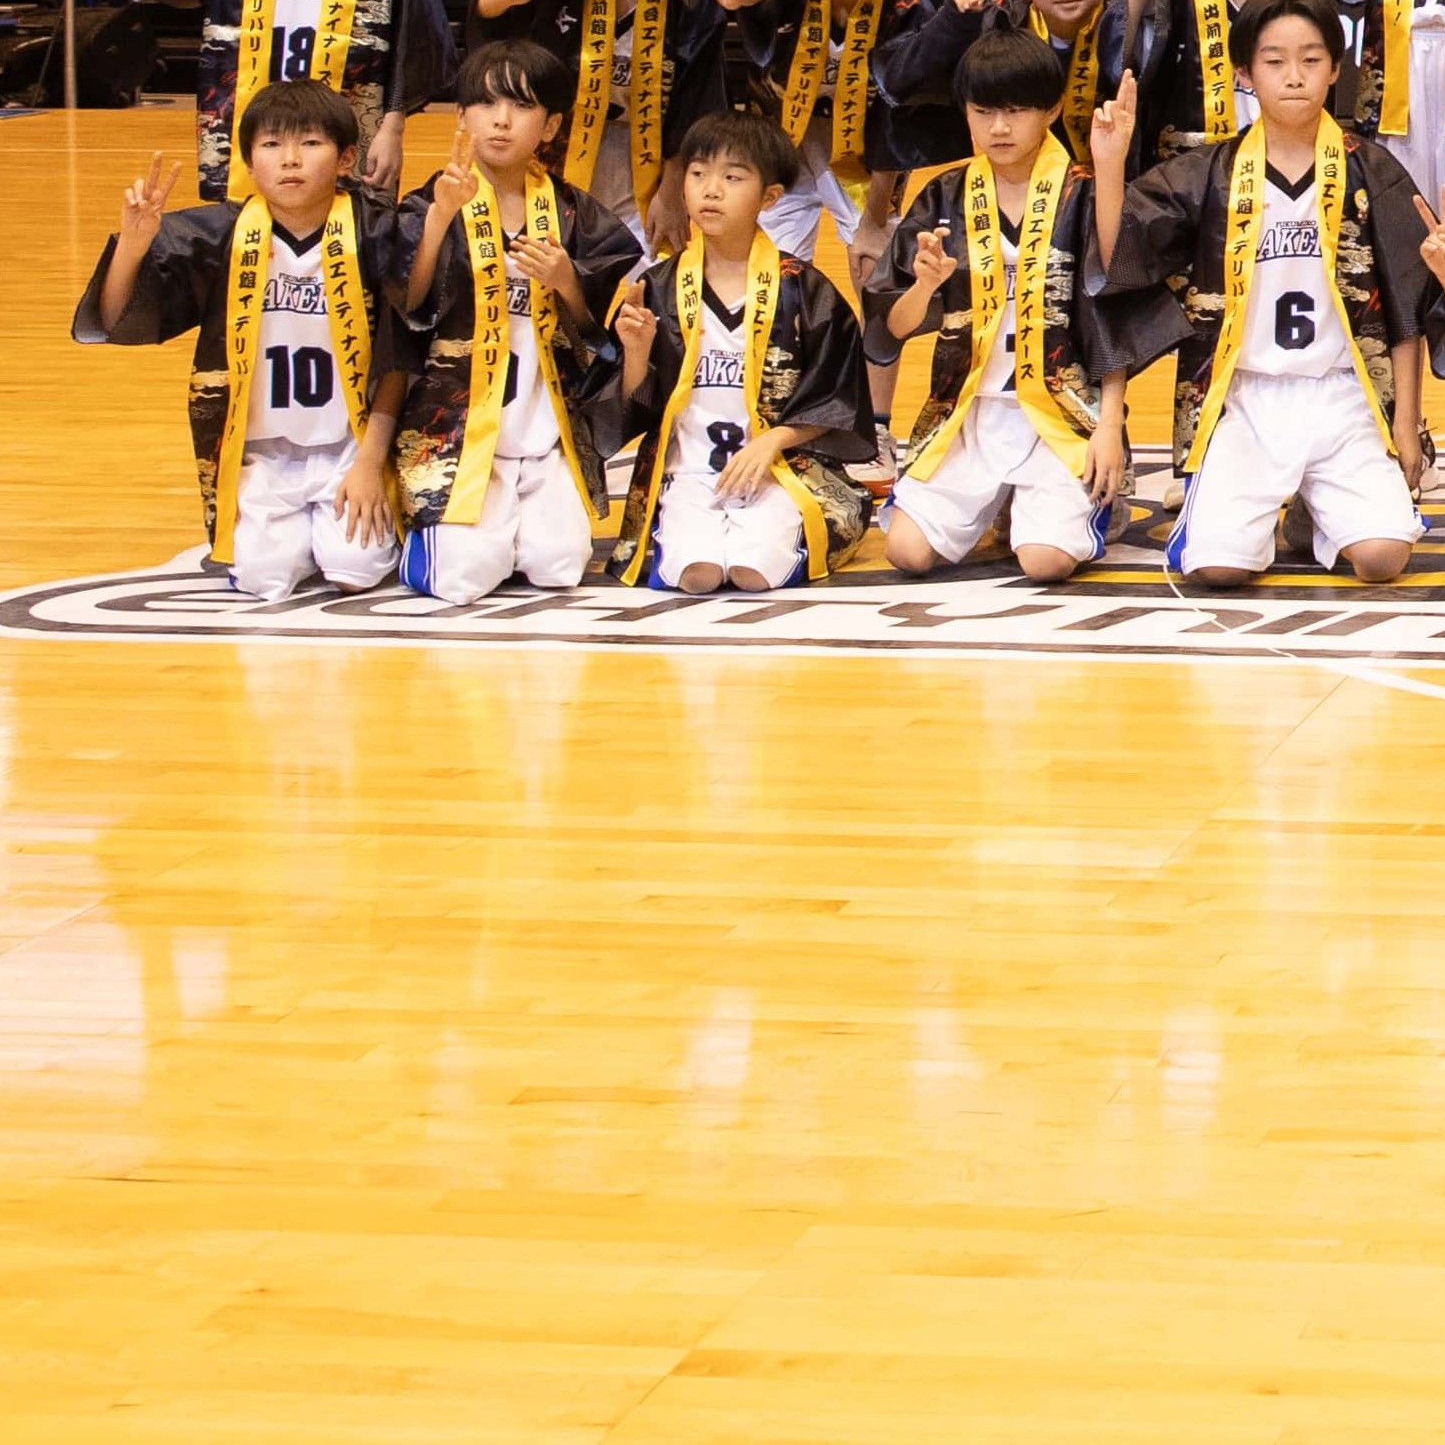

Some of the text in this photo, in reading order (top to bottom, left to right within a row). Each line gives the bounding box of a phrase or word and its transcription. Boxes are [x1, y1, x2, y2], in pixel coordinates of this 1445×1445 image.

[1021, 179, 1051, 379] 仙台エイティナイナーズ
[1275, 291, 1315, 350] 6
[265, 345, 333, 408] 10
